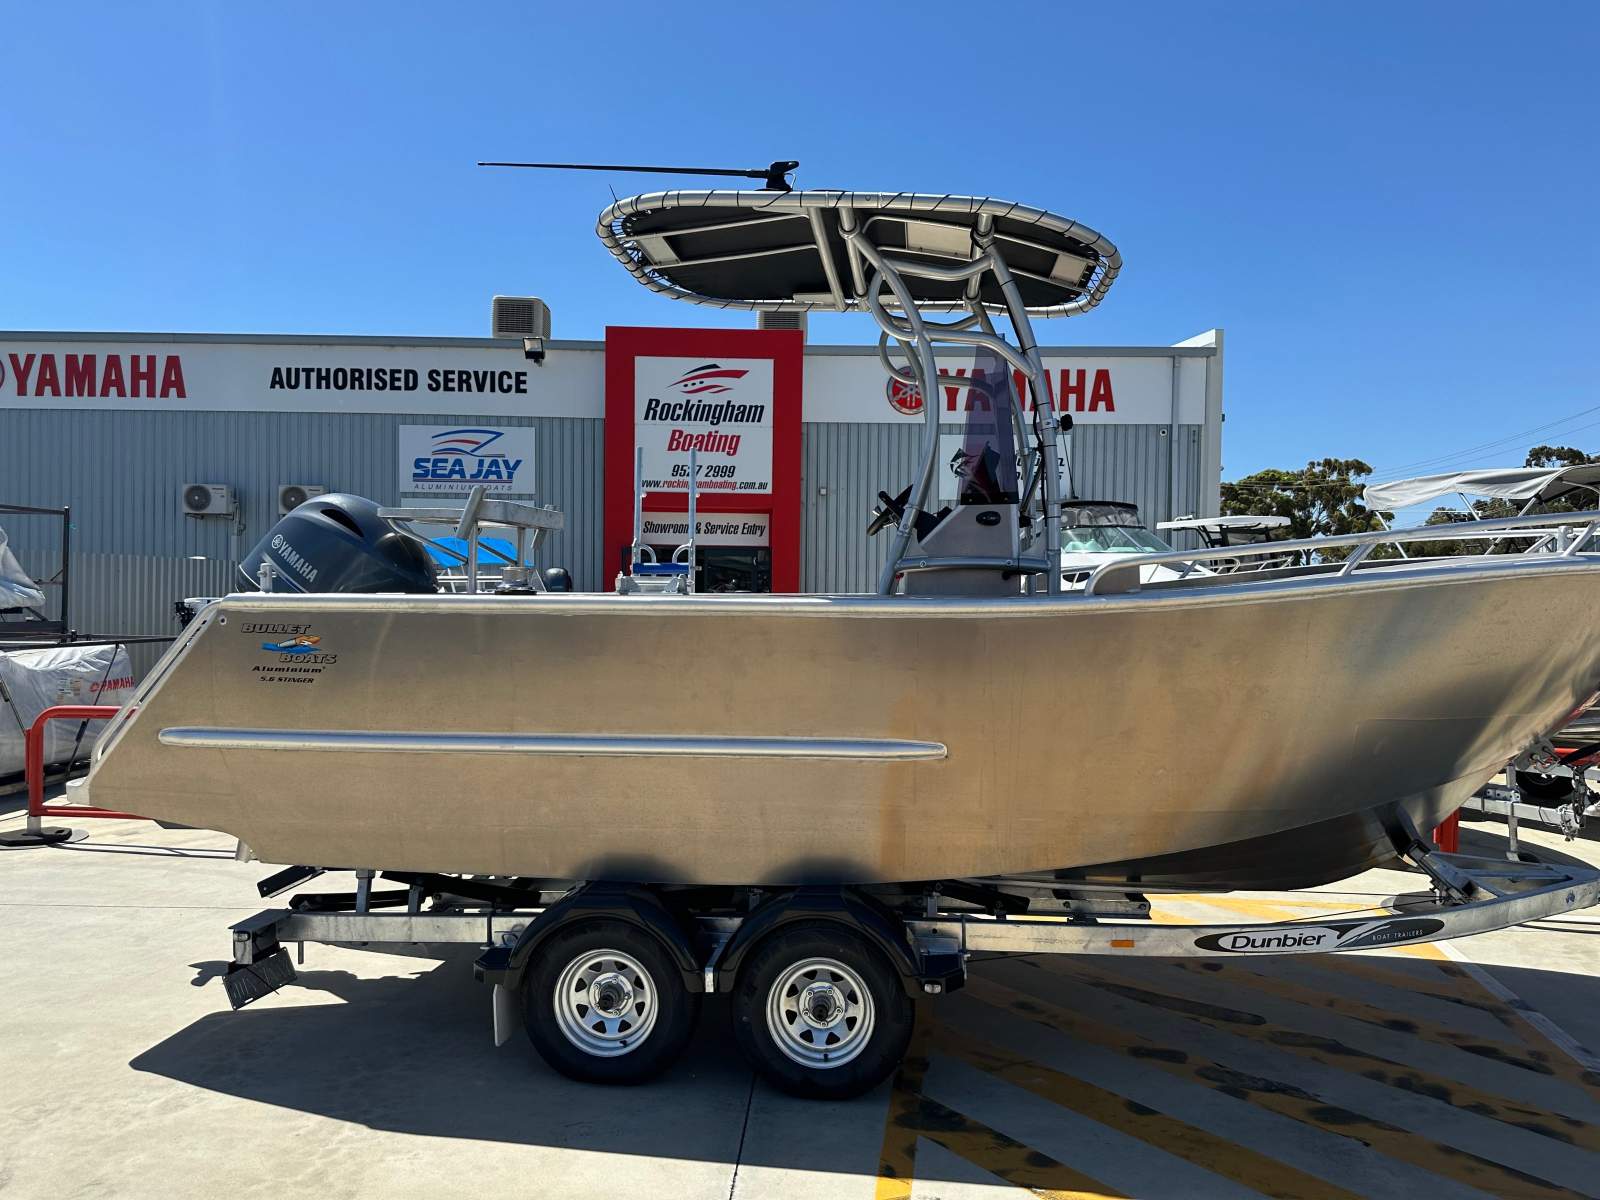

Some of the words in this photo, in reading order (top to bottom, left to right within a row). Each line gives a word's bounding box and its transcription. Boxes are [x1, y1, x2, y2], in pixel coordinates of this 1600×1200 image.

[8, 353, 187, 398] YAMAHA
[269, 367, 419, 391] AUTHORISED
[427, 369, 528, 393] SERVICE
[643, 398, 765, 426] Rockingham
[667, 429, 741, 456] Boating
[412, 457, 467, 479] SEA
[470, 458, 523, 480] JAY
[704, 465, 736, 478] 2999
[704, 521, 739, 535] Service
[741, 523, 766, 537] Entry
[278, 541, 318, 583] YAMAHA
[241, 623, 311, 634] BULLET
[279, 653, 338, 664] BOATS
[251, 665, 322, 673] Aluminium
[278, 676, 315, 684] STINGER
[1231, 933, 1326, 949] Dunbier
[1394, 930, 1424, 939] TRAILERS
